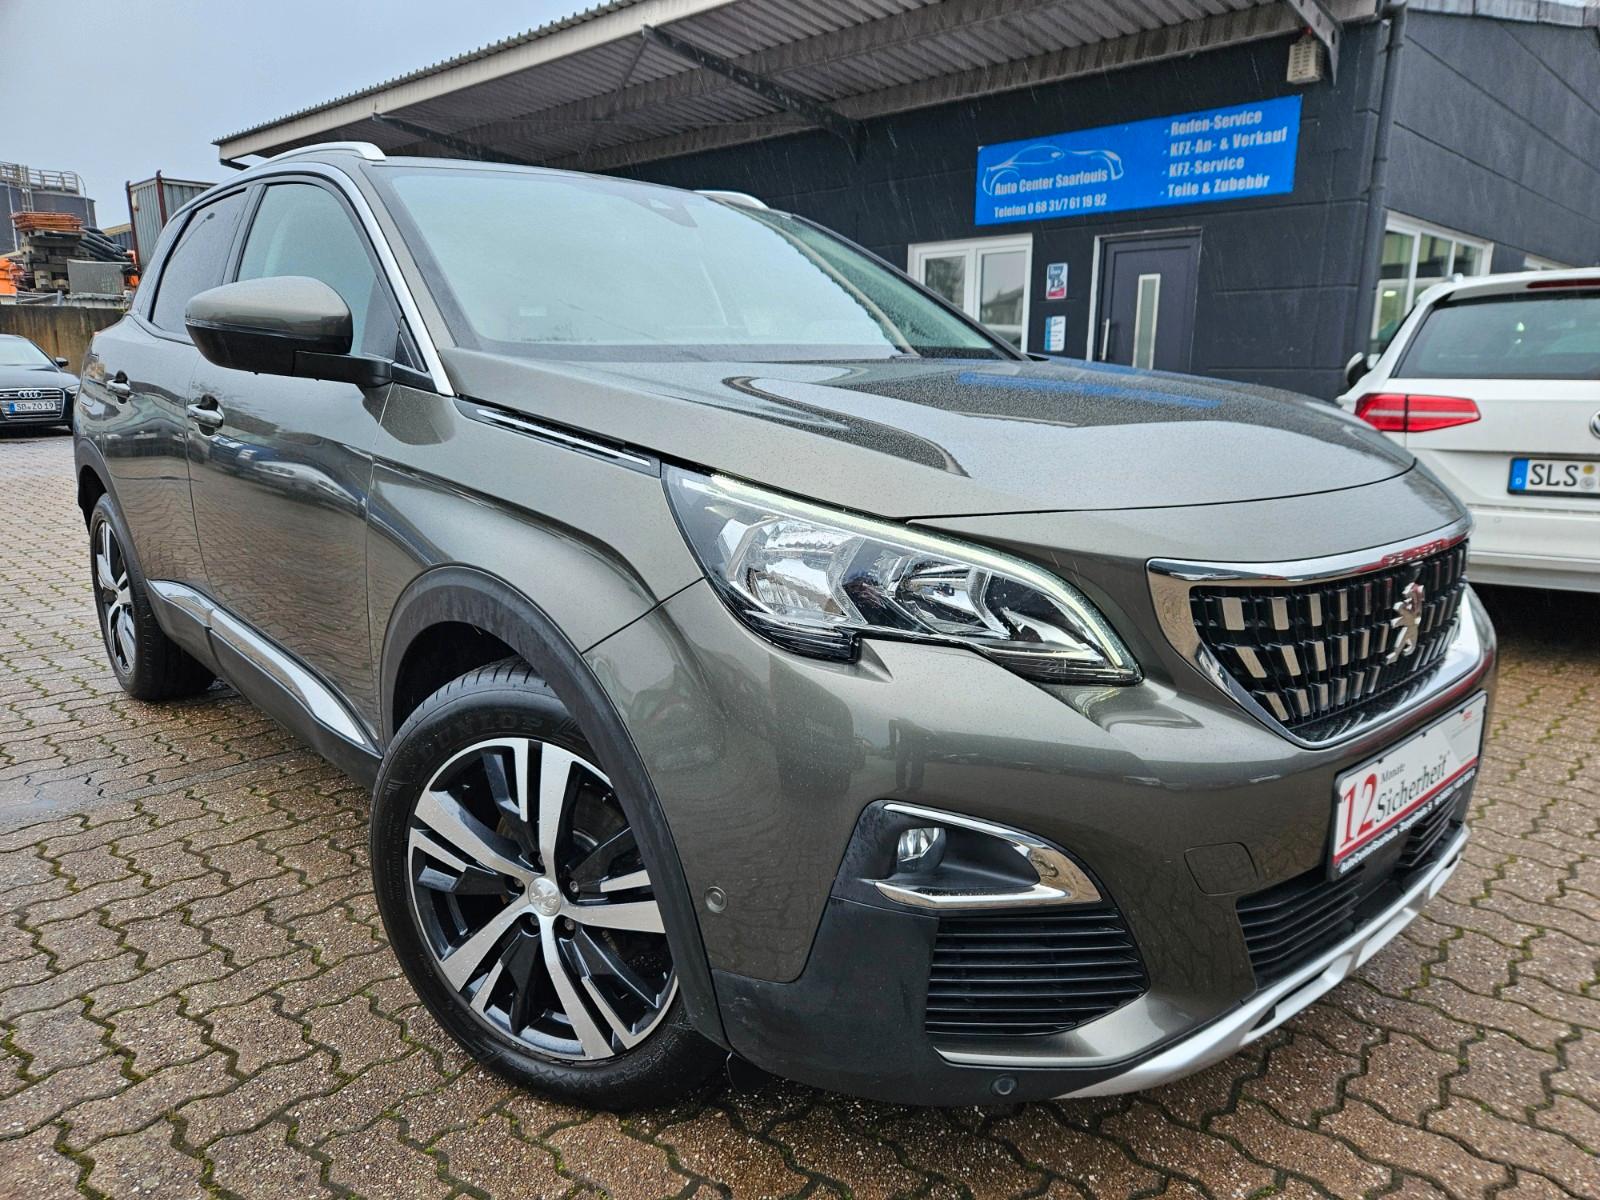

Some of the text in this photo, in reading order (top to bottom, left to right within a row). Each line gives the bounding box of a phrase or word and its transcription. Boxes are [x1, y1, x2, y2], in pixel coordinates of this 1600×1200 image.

[1171, 110, 1262, 136] Reifen-Service
[1170, 126, 1288, 156] KFZ-An- & Verkauf
[1169, 156, 1245, 177] KFZ-Service
[994, 168, 1108, 195] Auto Center Saarlouis
[1168, 173, 1271, 198] Teile & Zubehör
[994, 204, 1026, 218] Telefon
[1028, 202, 1034, 214] 0
[1035, 201, 1047, 213] 68
[1094, 192, 1107, 206] 92
[1529, 463, 1579, 487] SLS
[1340, 773, 1377, 849] 12
